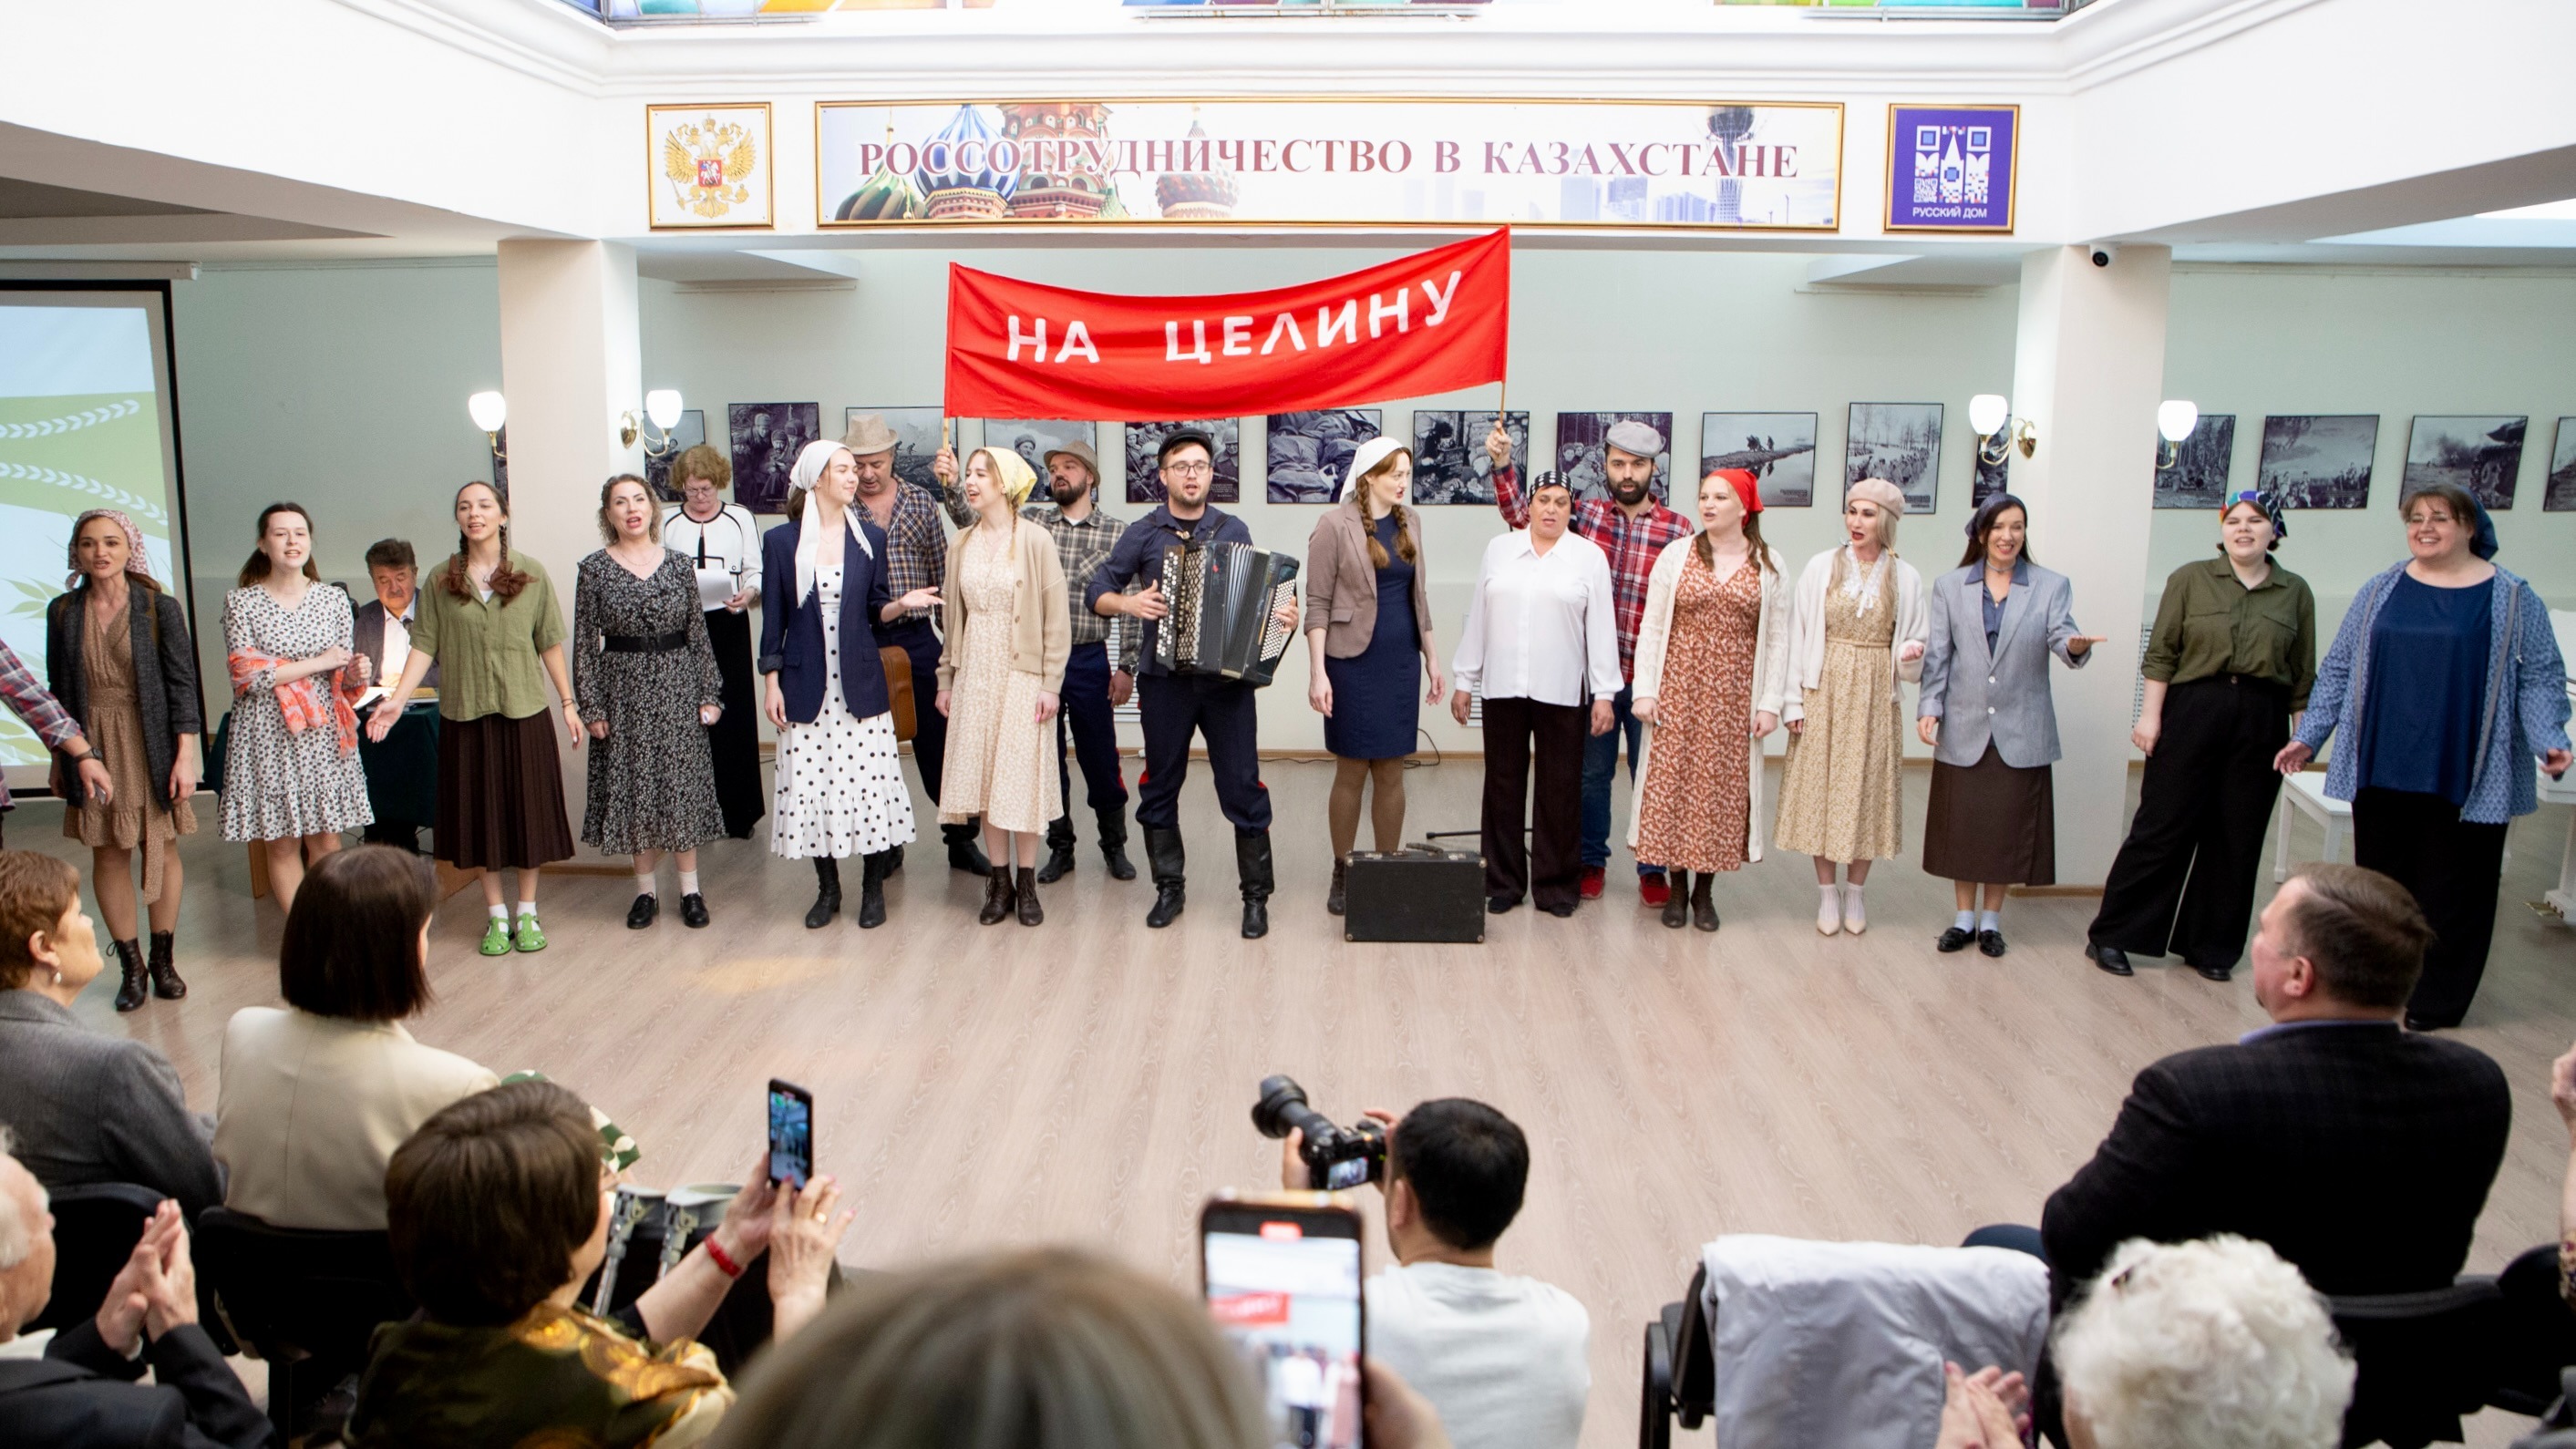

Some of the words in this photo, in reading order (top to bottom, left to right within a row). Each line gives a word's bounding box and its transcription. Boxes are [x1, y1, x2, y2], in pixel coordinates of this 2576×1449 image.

[860, 139, 1412, 178] РОССОТРУДНИЧЕСТВО
[1435, 140, 1460, 173] В
[1484, 142, 1798, 178] КАЗАХСТАНЕ
[1912, 206, 1961, 218] РУССКИЙ
[1963, 208, 1987, 219] ДОМ
[1007, 315, 1100, 363] НА
[1165, 271, 1461, 365] ЦЕЛИНУ
